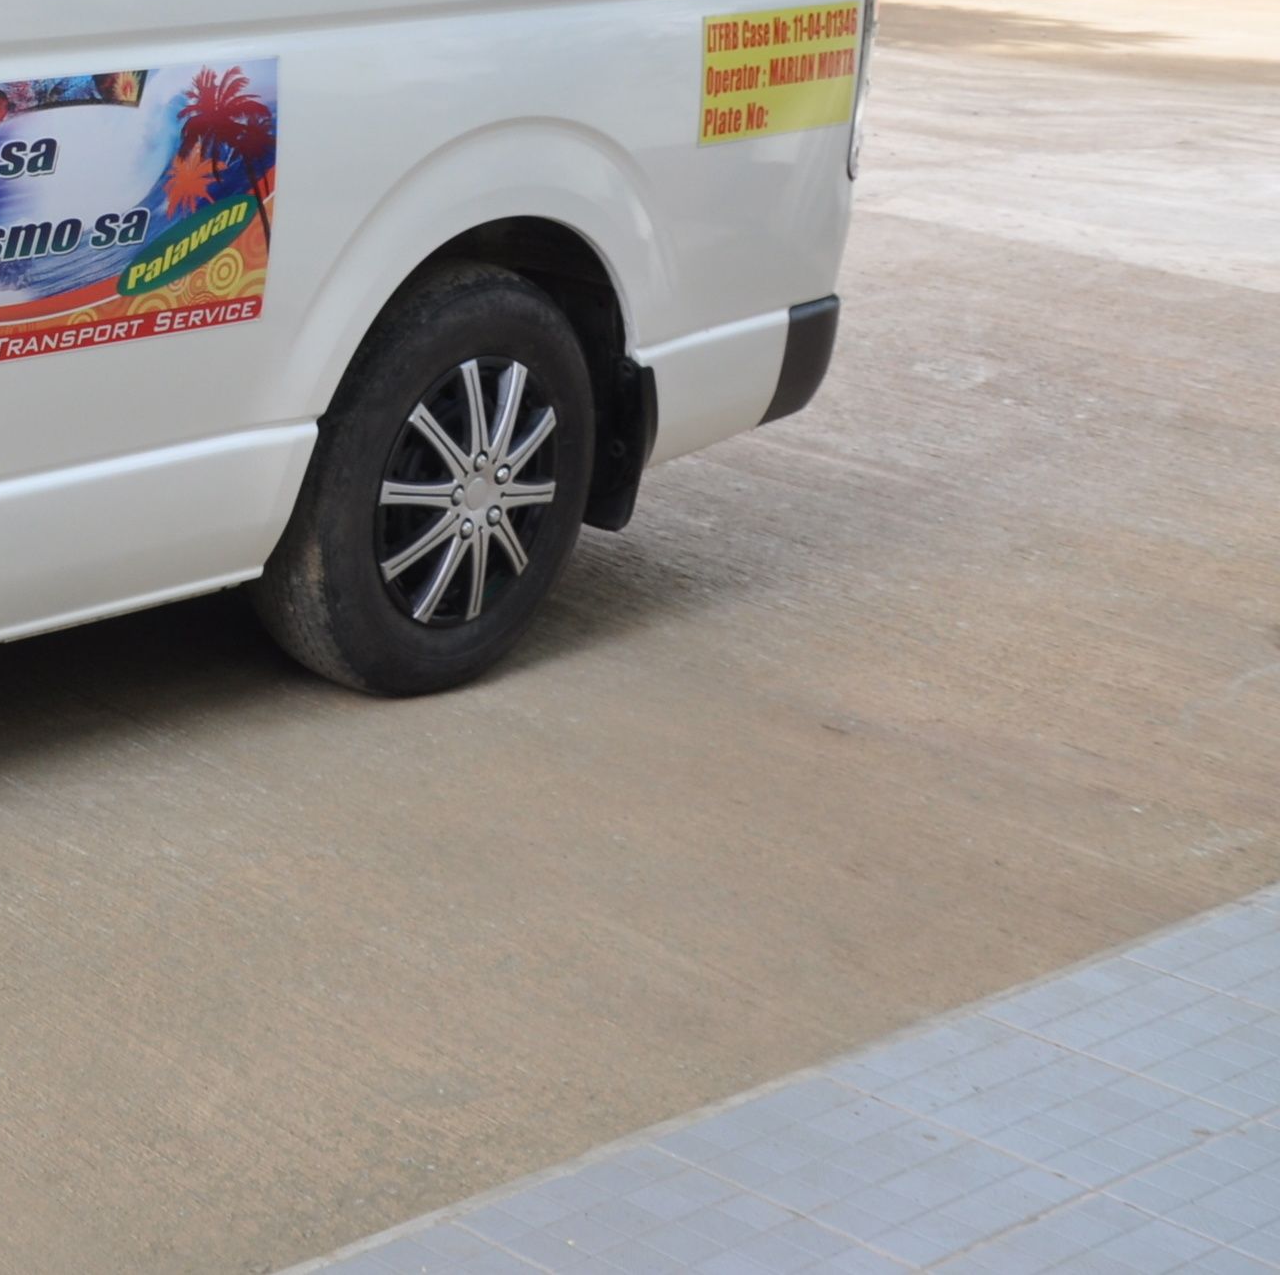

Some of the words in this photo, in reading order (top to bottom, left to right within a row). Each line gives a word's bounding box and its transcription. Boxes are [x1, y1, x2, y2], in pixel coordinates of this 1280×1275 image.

[707, 22, 738, 53] LTFRB
[742, 20, 770, 48] Case
[768, 53, 816, 87] MARLON
[703, 107, 742, 137] Plate
[90, 207, 150, 250] sa
[127, 201, 249, 291] Palawan
[153, 300, 257, 334] SERVICE
